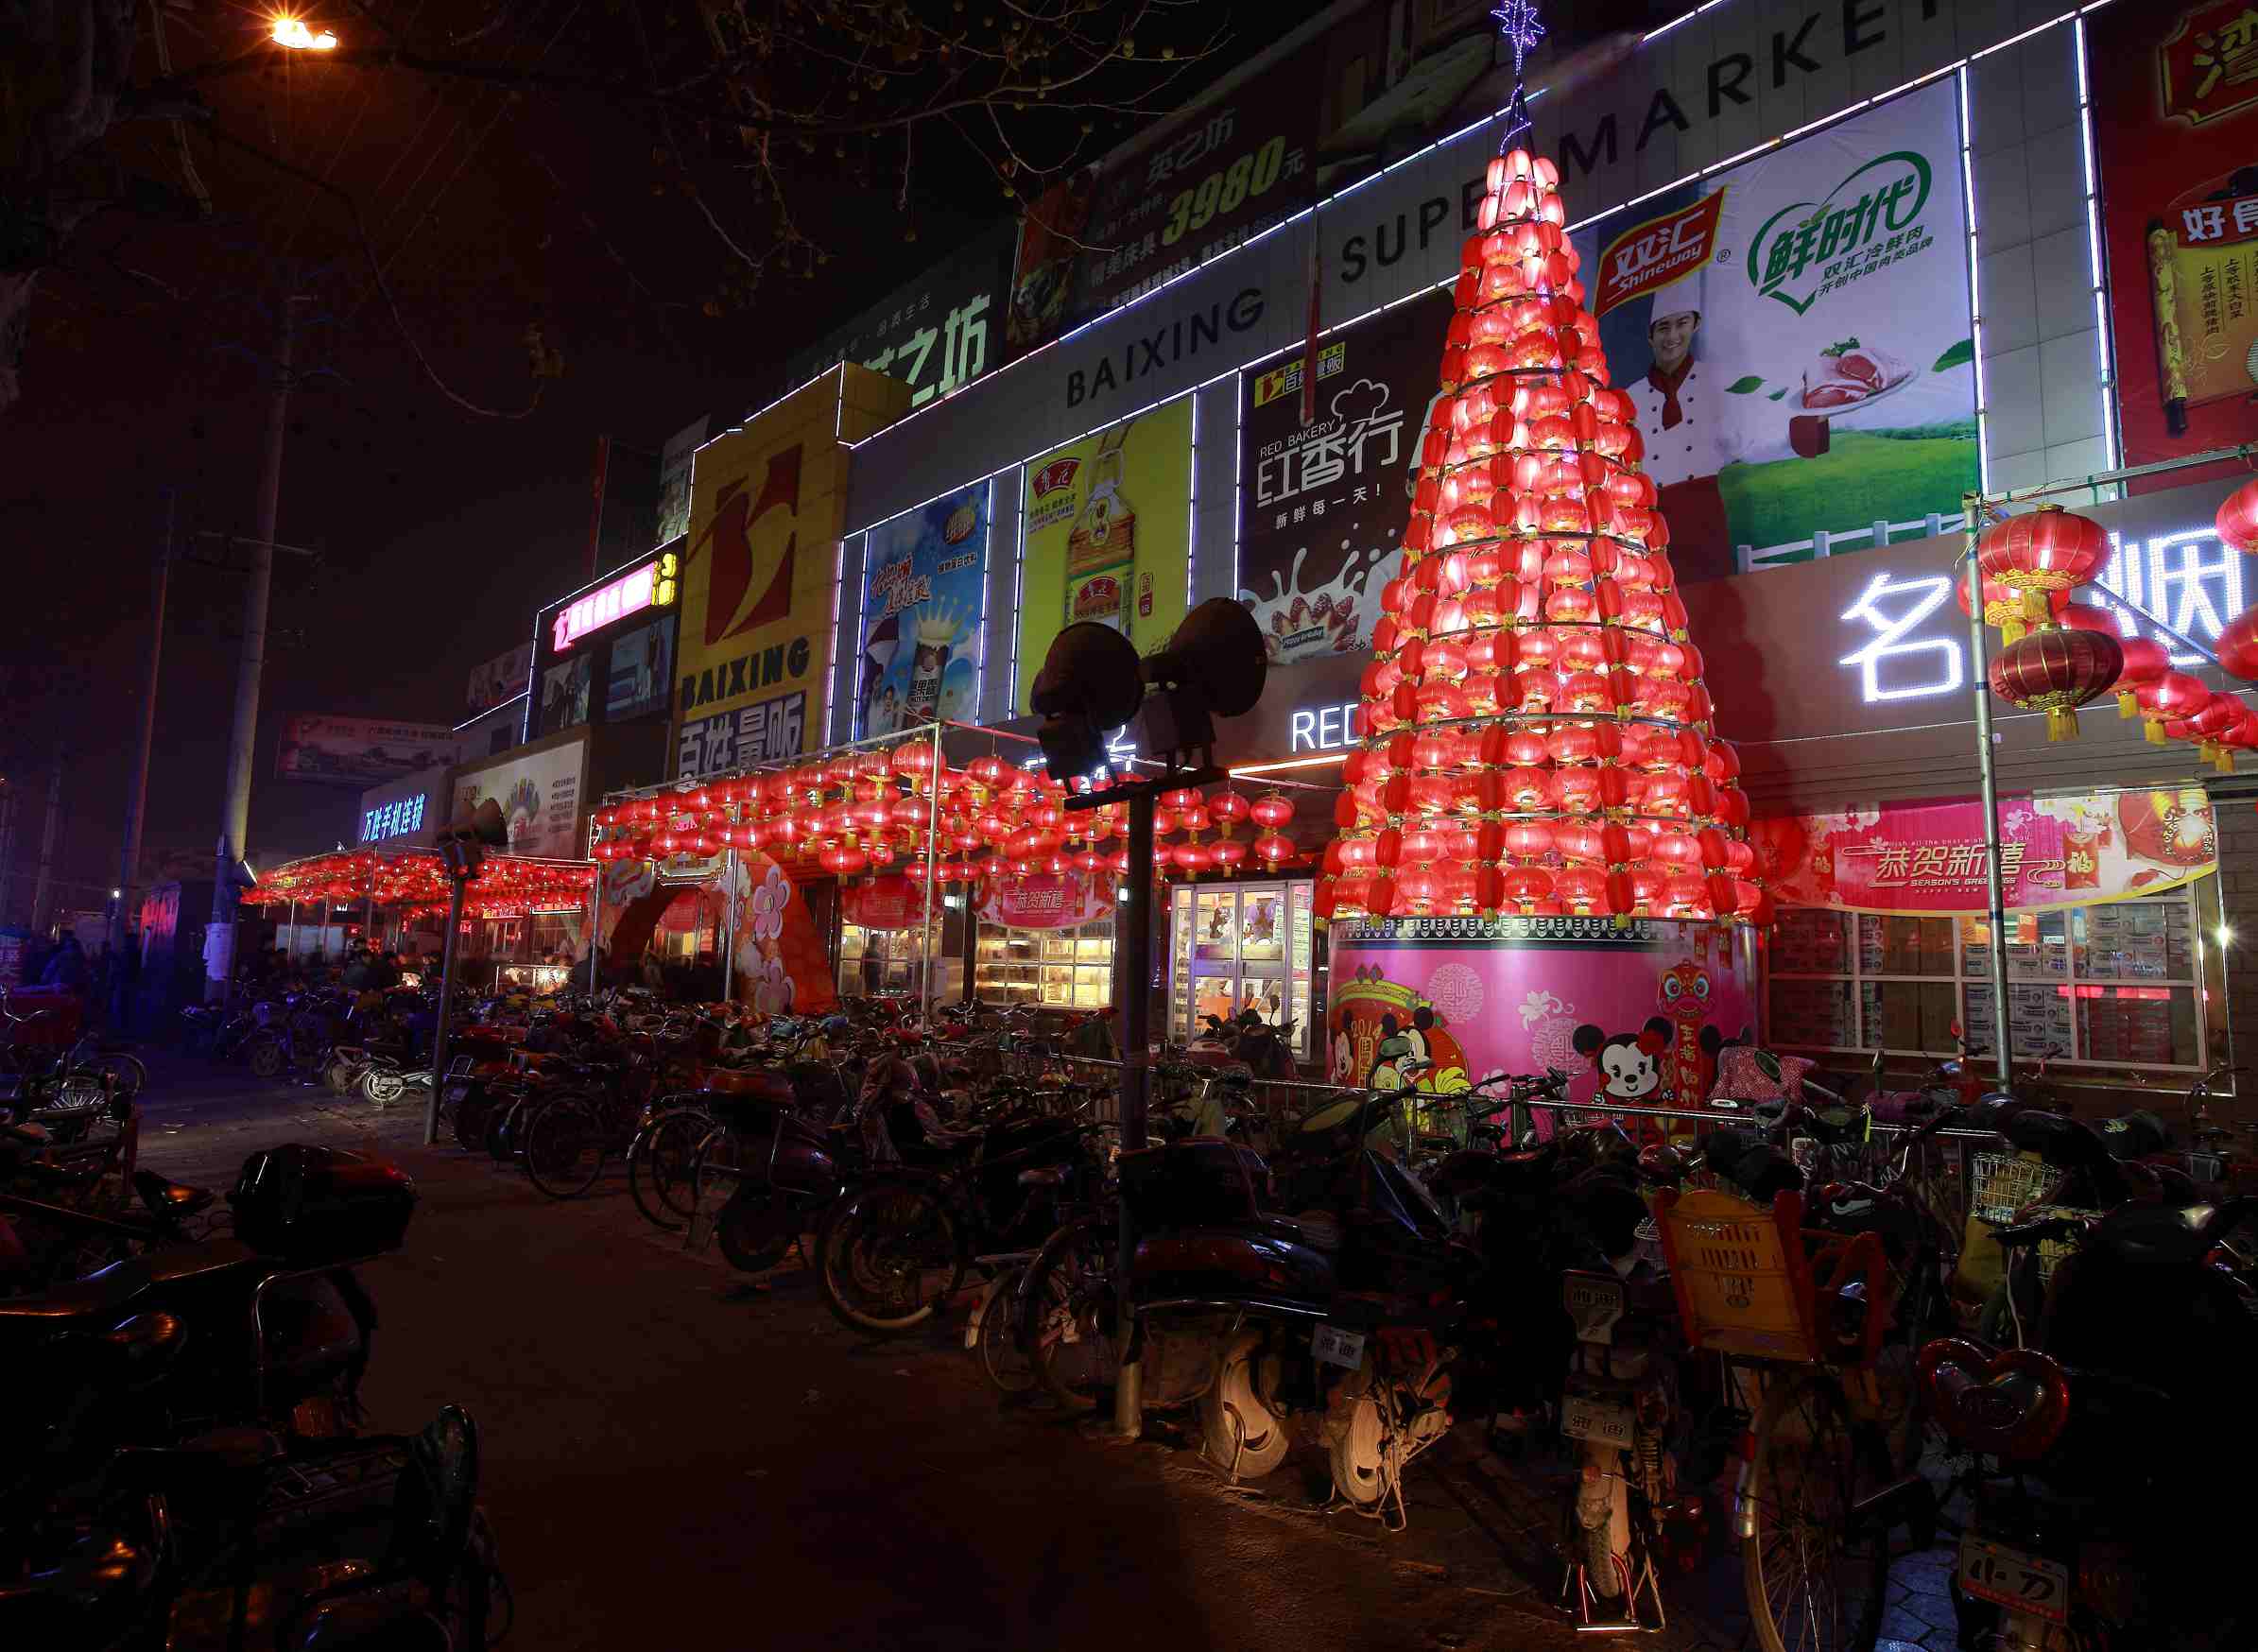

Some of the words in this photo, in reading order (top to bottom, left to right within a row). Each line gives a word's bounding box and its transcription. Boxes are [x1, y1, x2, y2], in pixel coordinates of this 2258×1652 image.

[1560, 0, 1937, 185] MARKE
[1609, 208, 1707, 284] 双汇
[1764, 173, 1916, 284] 鲜时代
[1618, 246, 1703, 291] Shineway
[1067, 288, 1264, 408] BAIXING
[1260, 442, 1282, 457] RED
[1287, 421, 1336, 447] BAKERY
[681, 635, 810, 711] BAIXING
[1876, 841, 2027, 878] 恭贺新禧
[1964, 876, 2017, 886] GREEGS
